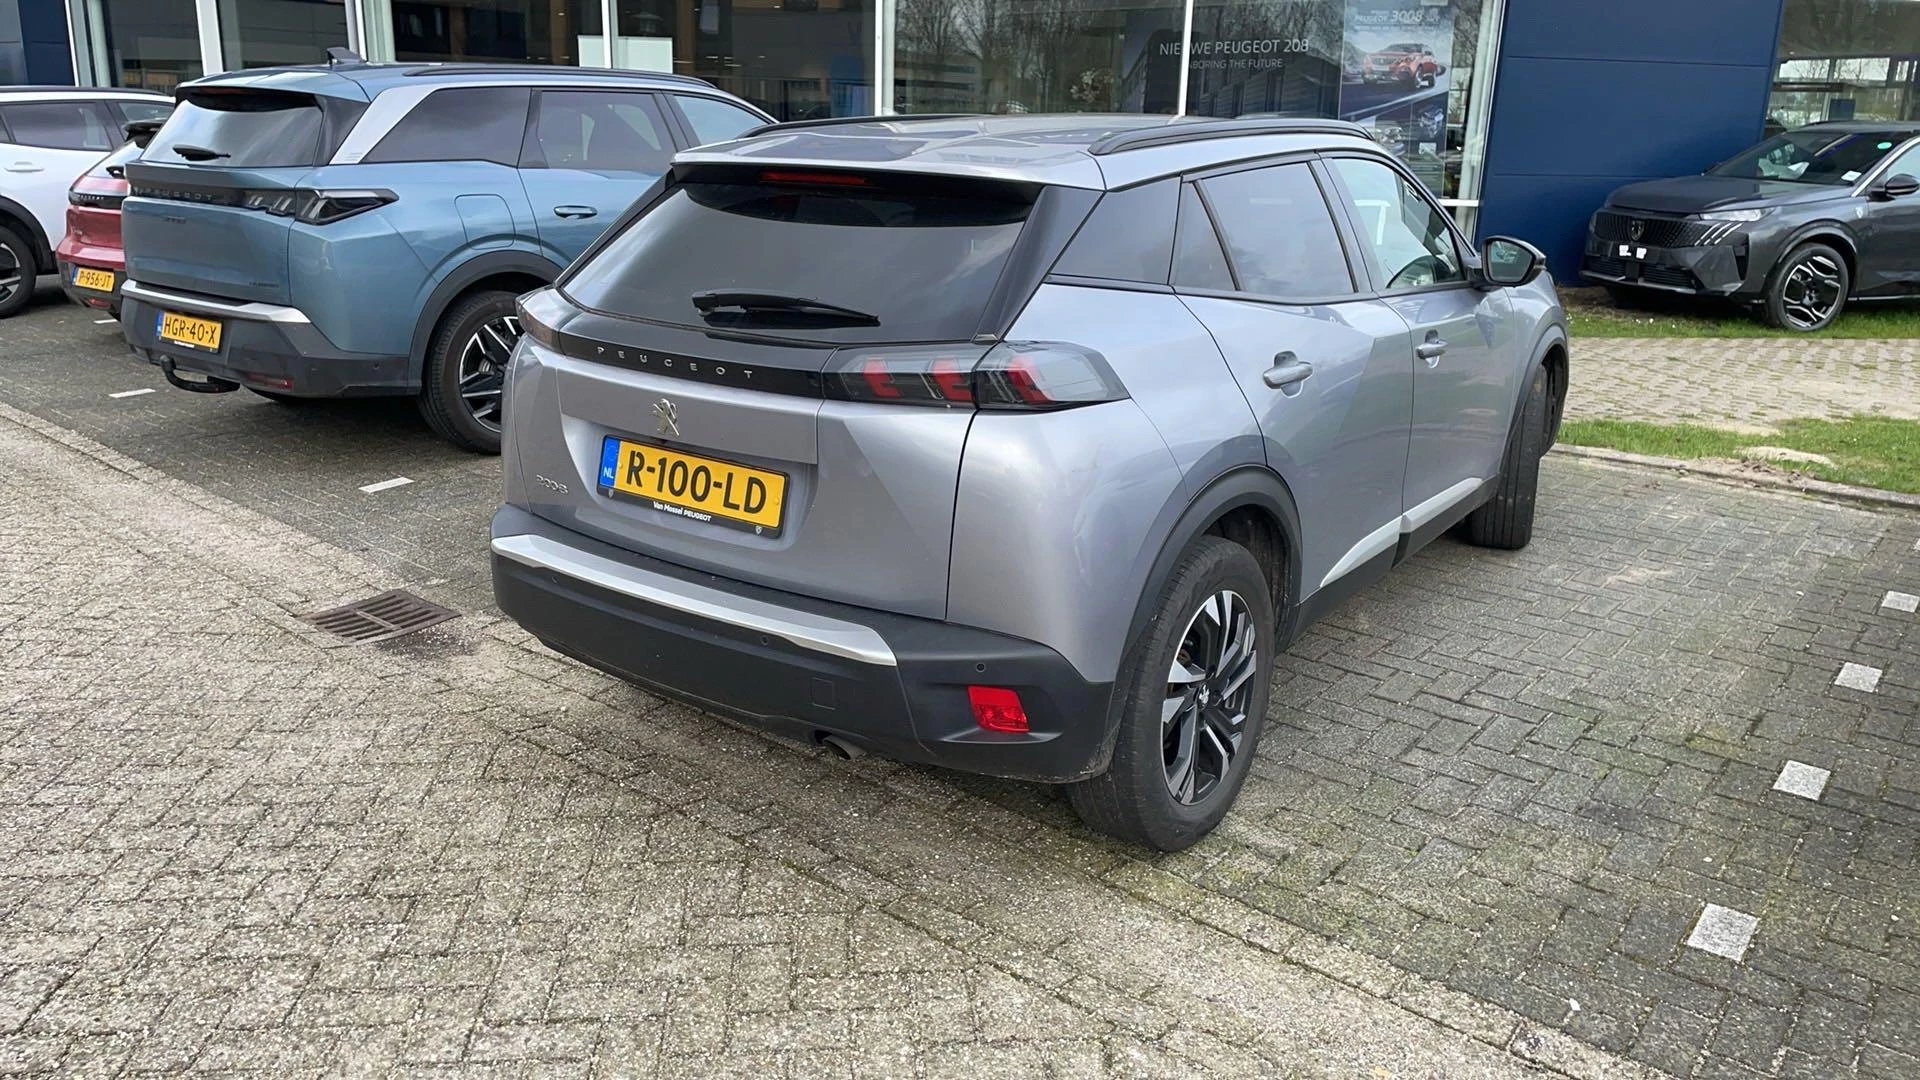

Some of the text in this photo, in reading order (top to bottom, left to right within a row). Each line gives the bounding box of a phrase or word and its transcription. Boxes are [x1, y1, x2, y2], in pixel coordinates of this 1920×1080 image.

[1391, 9, 1424, 22] 3008
[1159, 38, 1309, 55] NIEWE PEUGEOT 208
[1229, 59, 1246, 69] THE
[1248, 58, 1284, 68] FUTURE
[78, 270, 112, 289] P-956-JT
[163, 315, 217, 344] HGR-40-X
[597, 346, 753, 379] PEUGEOT
[603, 467, 614, 479] NL
[626, 450, 767, 515] R-100-LD
[653, 501, 712, 522] Van Mossel PEUGEOT
